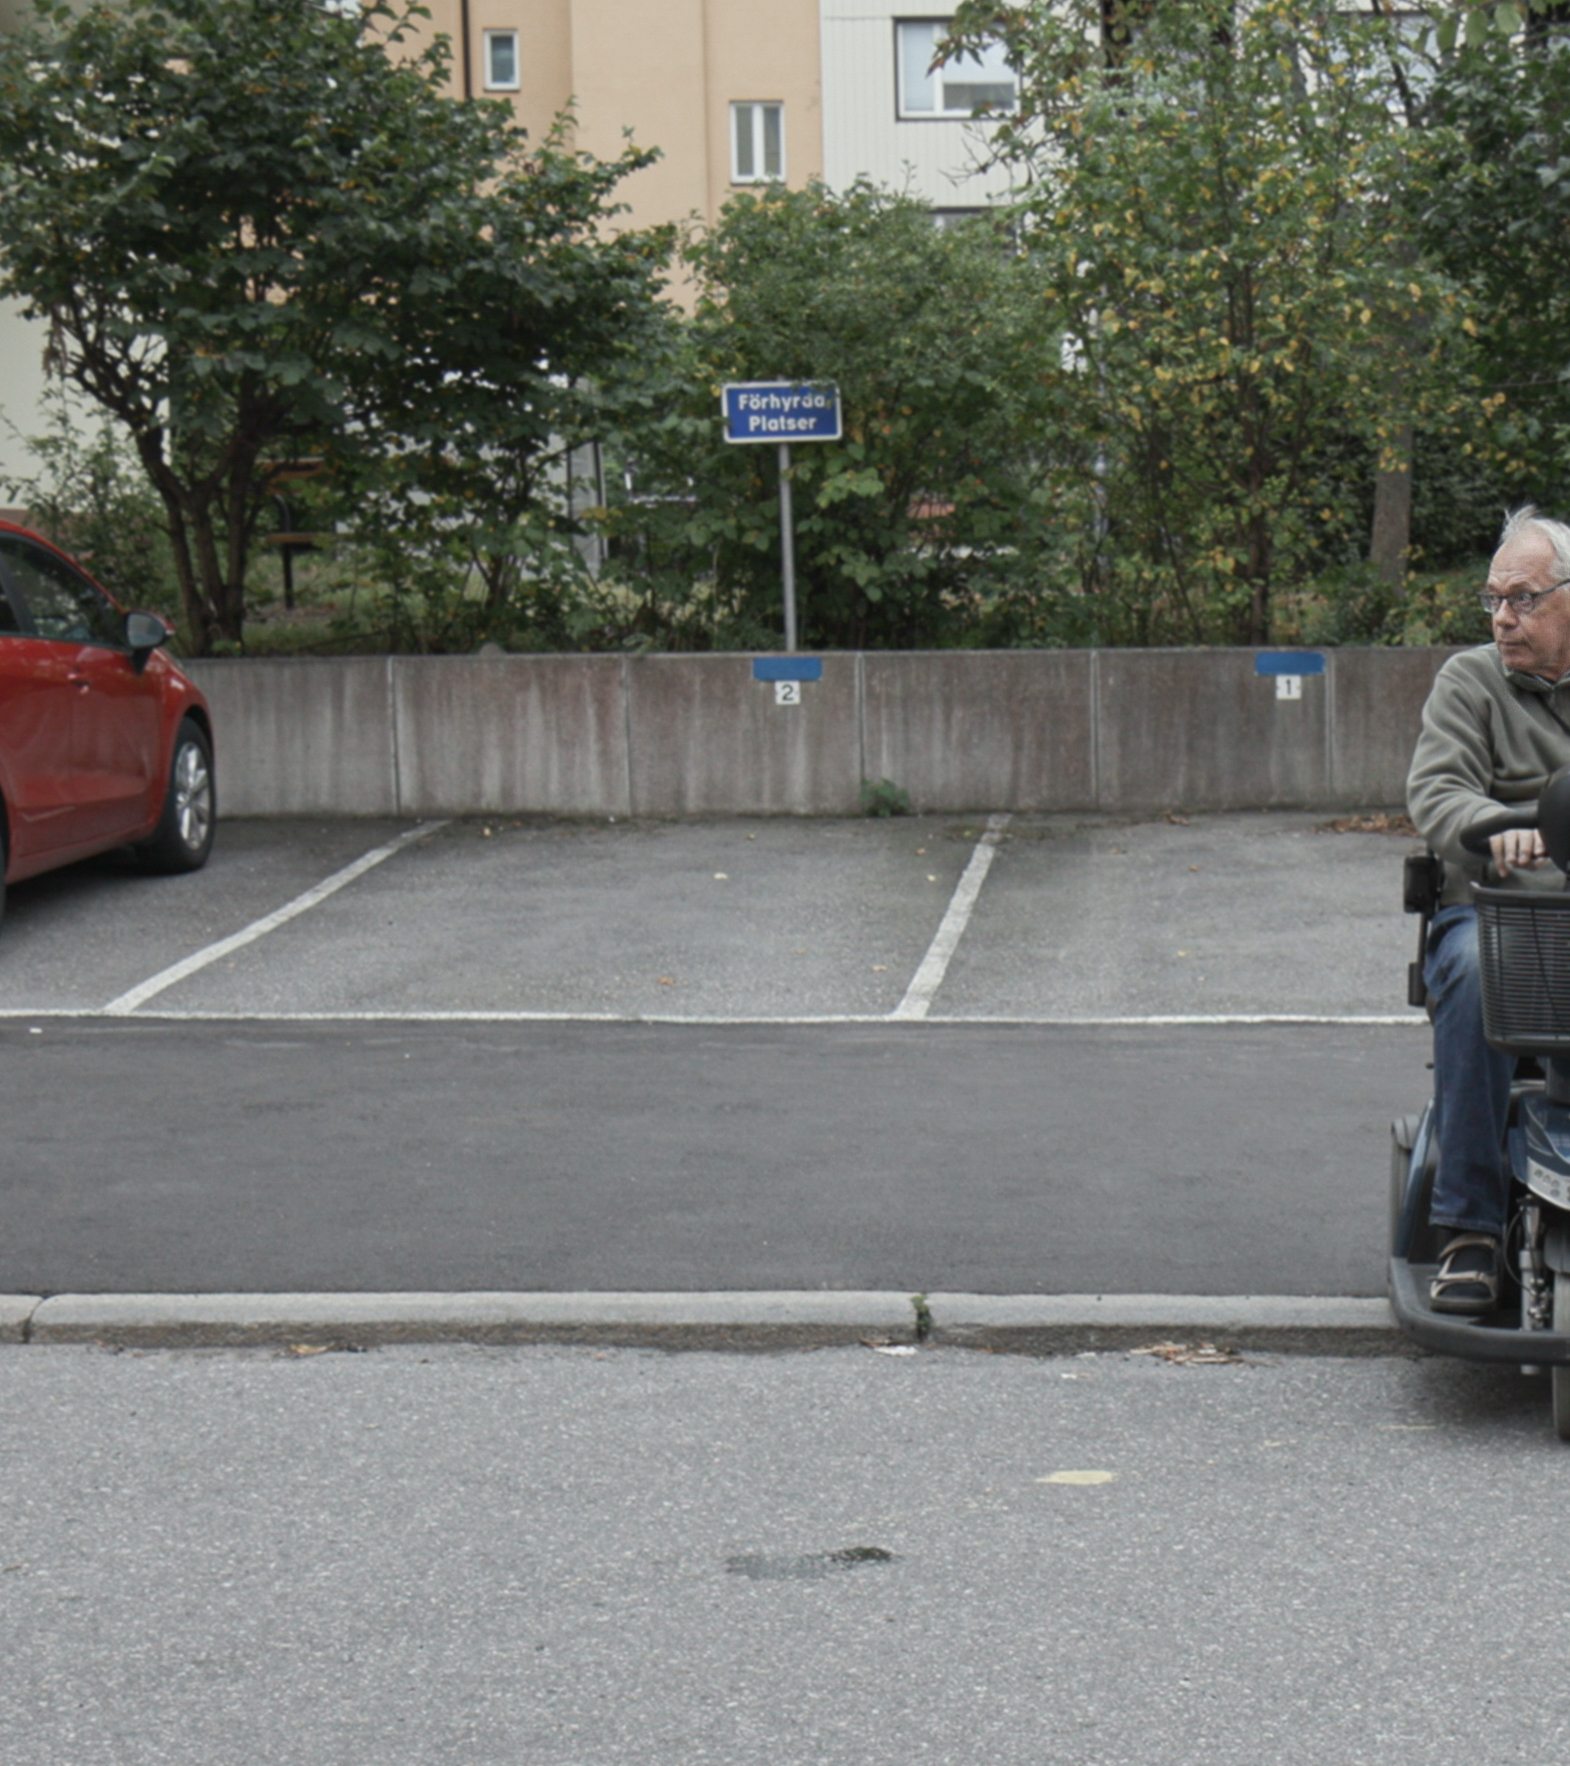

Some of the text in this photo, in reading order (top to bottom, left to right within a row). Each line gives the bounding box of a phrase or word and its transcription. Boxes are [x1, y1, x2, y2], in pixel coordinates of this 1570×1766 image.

[749, 415, 817, 432] Platser
[781, 684, 794, 701] 2
[1285, 679, 1292, 696] 1
